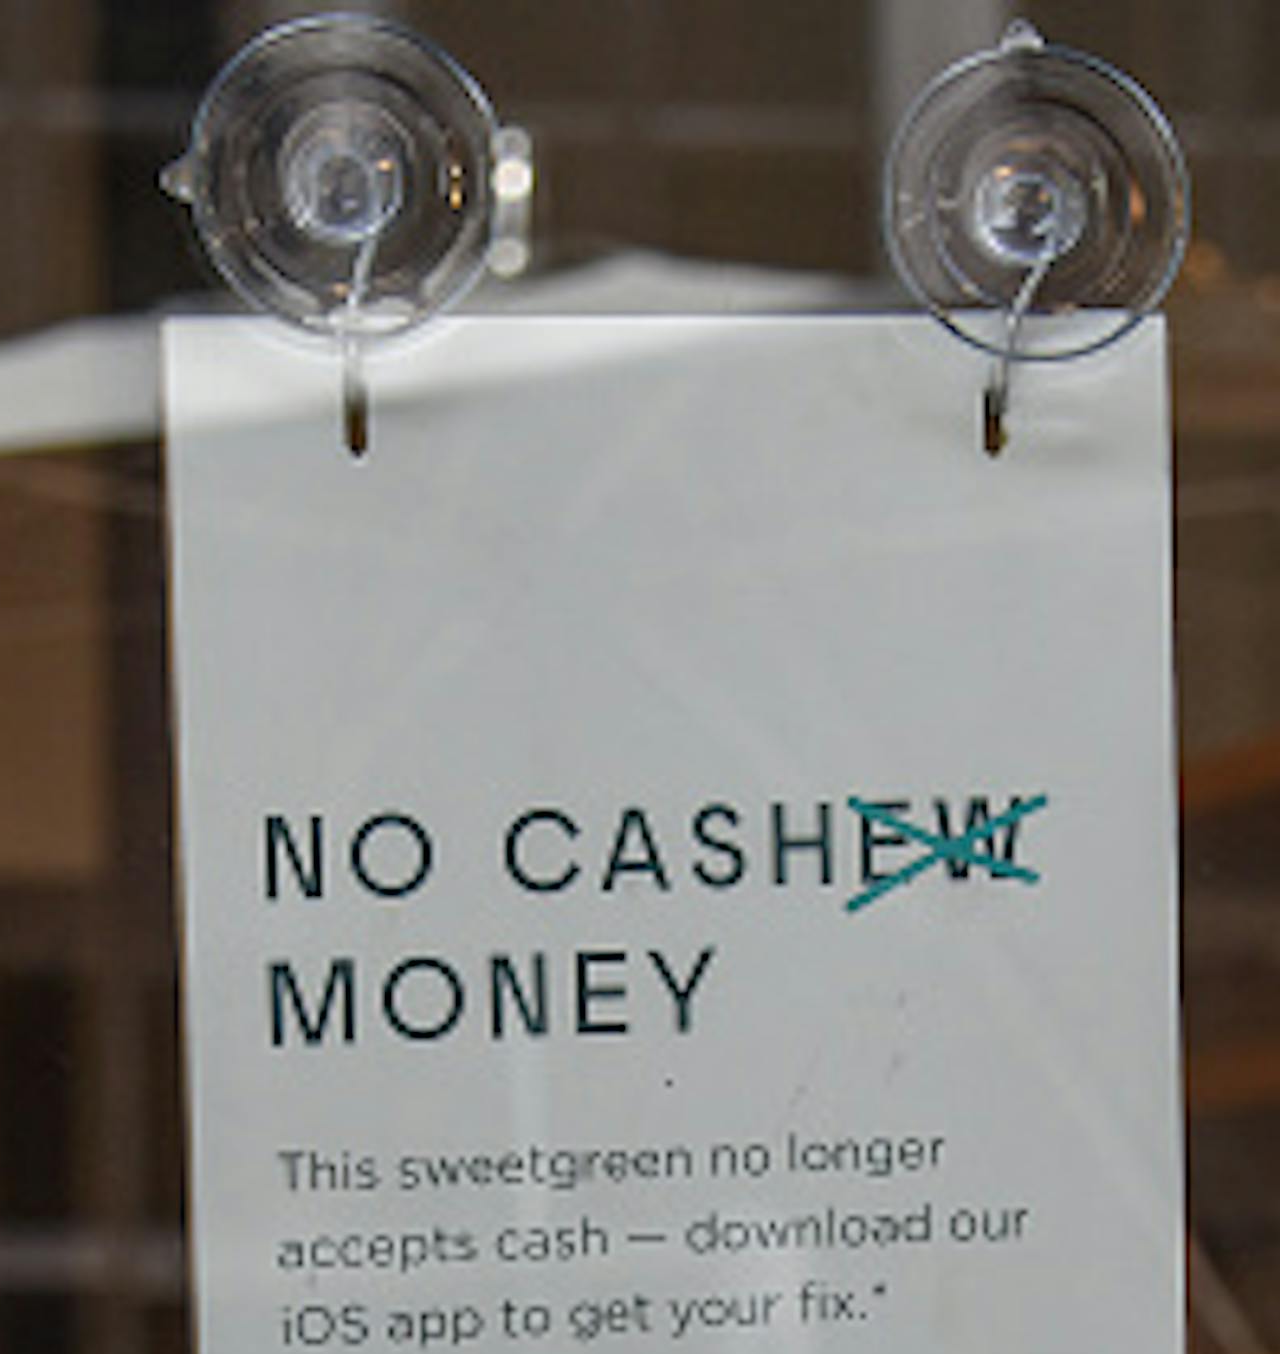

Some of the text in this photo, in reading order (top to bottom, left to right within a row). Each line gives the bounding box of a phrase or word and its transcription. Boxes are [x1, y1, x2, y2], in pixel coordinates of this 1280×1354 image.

[264, 810, 433, 900] NO
[269, 947, 716, 1047] MONEY
[276, 1132, 946, 1193] This sweetgreen no longer
[276, 1229, 477, 1273] accepts
[495, 1216, 610, 1262] cash
[686, 1203, 933, 1255] download
[949, 1203, 1030, 1243] our
[282, 1304, 370, 1347] iOS
[386, 1303, 484, 1348] app
[501, 1299, 551, 1338] to
[568, 1293, 652, 1343] get
[669, 1288, 782, 1338] your
